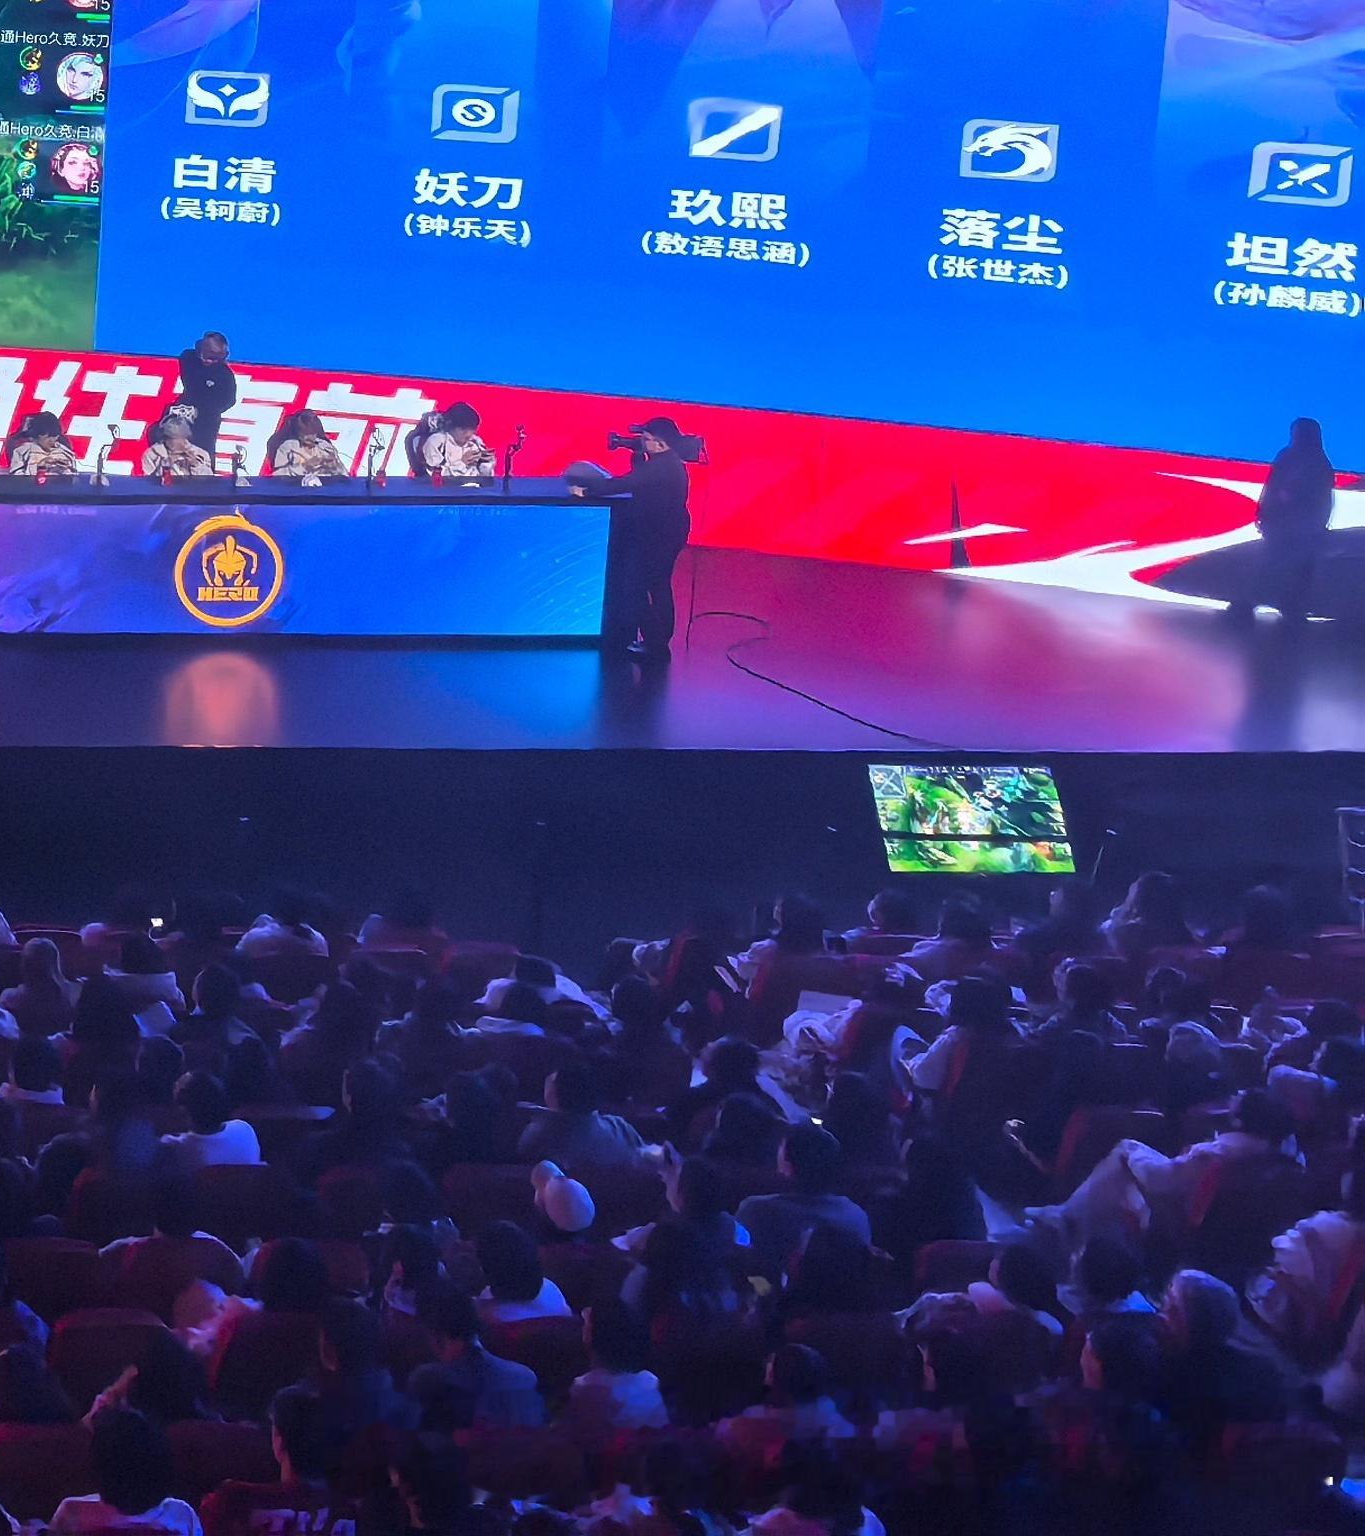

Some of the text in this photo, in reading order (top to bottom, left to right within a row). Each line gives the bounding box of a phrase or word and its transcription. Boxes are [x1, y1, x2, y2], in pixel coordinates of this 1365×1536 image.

[88, 89, 105, 103] 15
[84, 180, 100, 194] 15
[173, 154, 277, 194] 白清
[412, 167, 524, 210] 妖刀
[668, 189, 788, 231] 玖熙
[403, 212, 532, 249] (钟乐天)
[938, 208, 1065, 255] 落尘
[927, 253, 1069, 290] (张世杰)
[1225, 231, 1359, 283] 坦然
